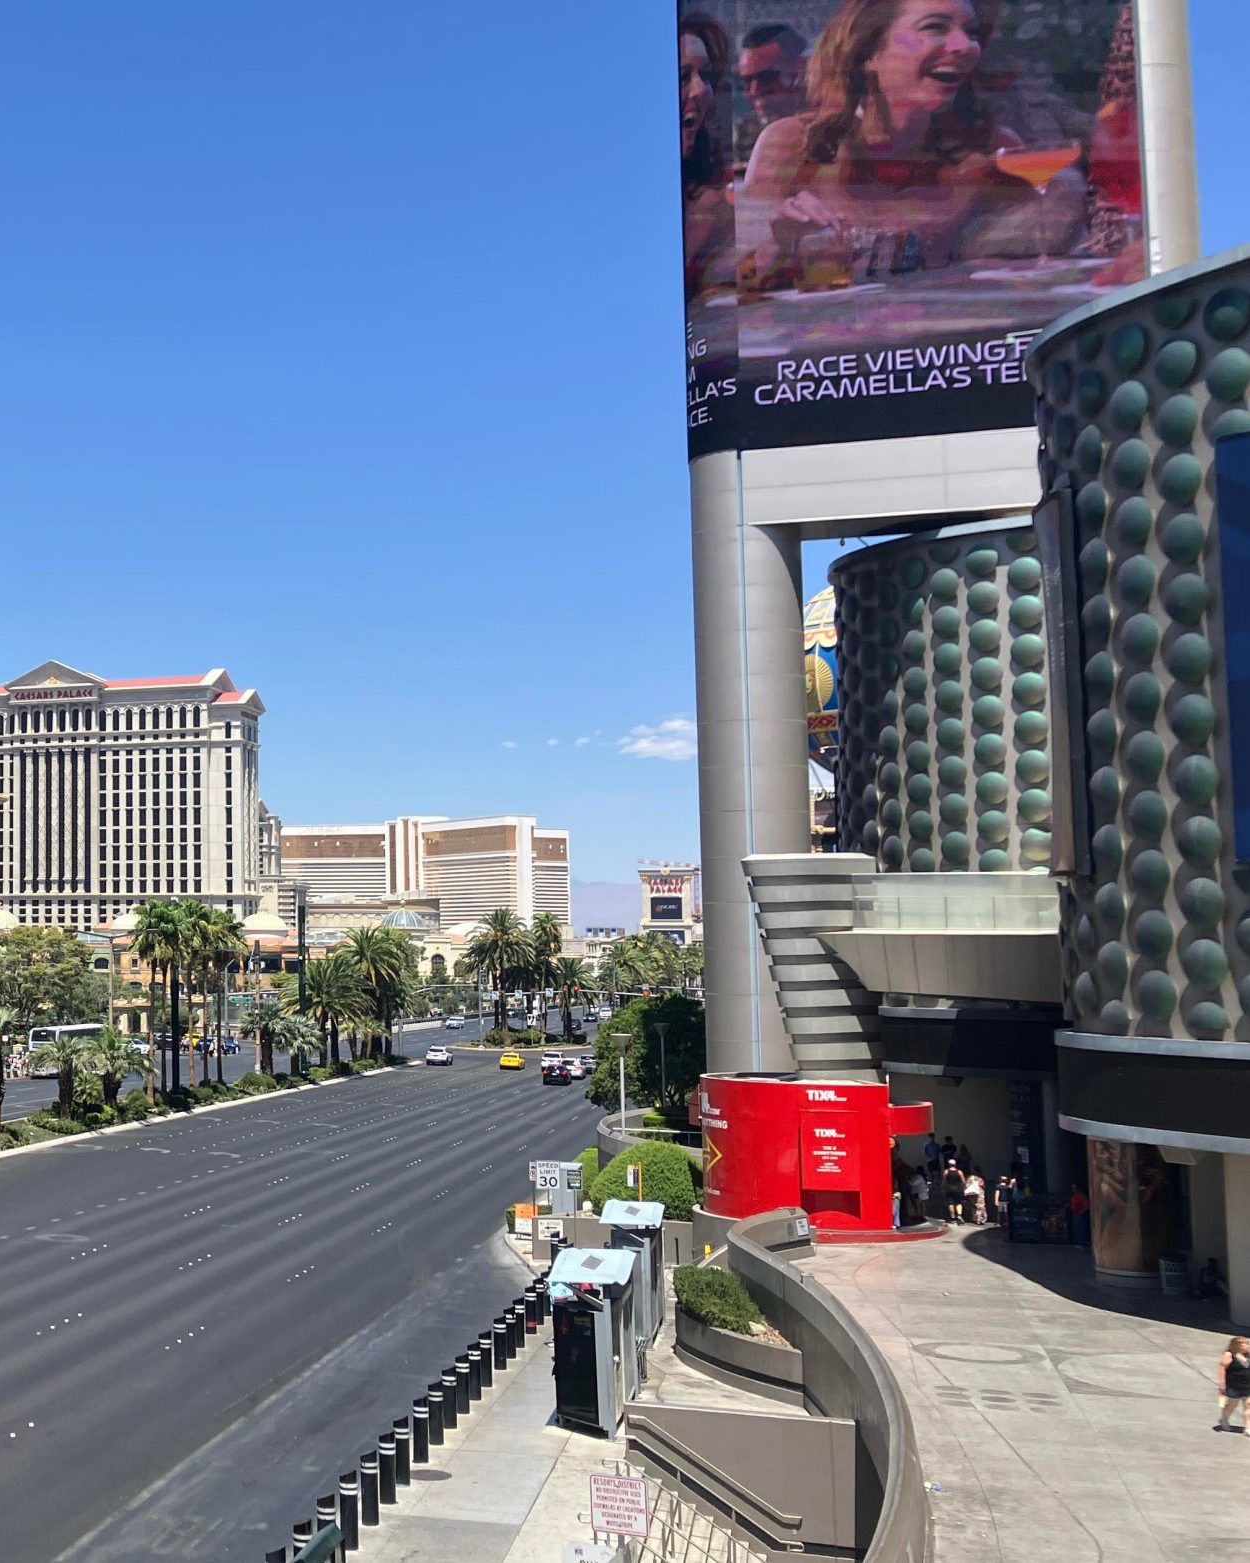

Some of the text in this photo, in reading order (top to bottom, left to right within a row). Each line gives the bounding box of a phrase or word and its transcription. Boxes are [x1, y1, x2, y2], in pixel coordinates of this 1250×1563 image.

[777, 354, 857, 381] RACE
[864, 340, 1007, 373] VIEWING
[754, 361, 1028, 405] CARAMELLA'S TE
[14, 689, 93, 700] CAESARS PALACE
[539, 1176, 558, 1187] 30
[593, 1477, 641, 1490] RESORTS DISTRICT
